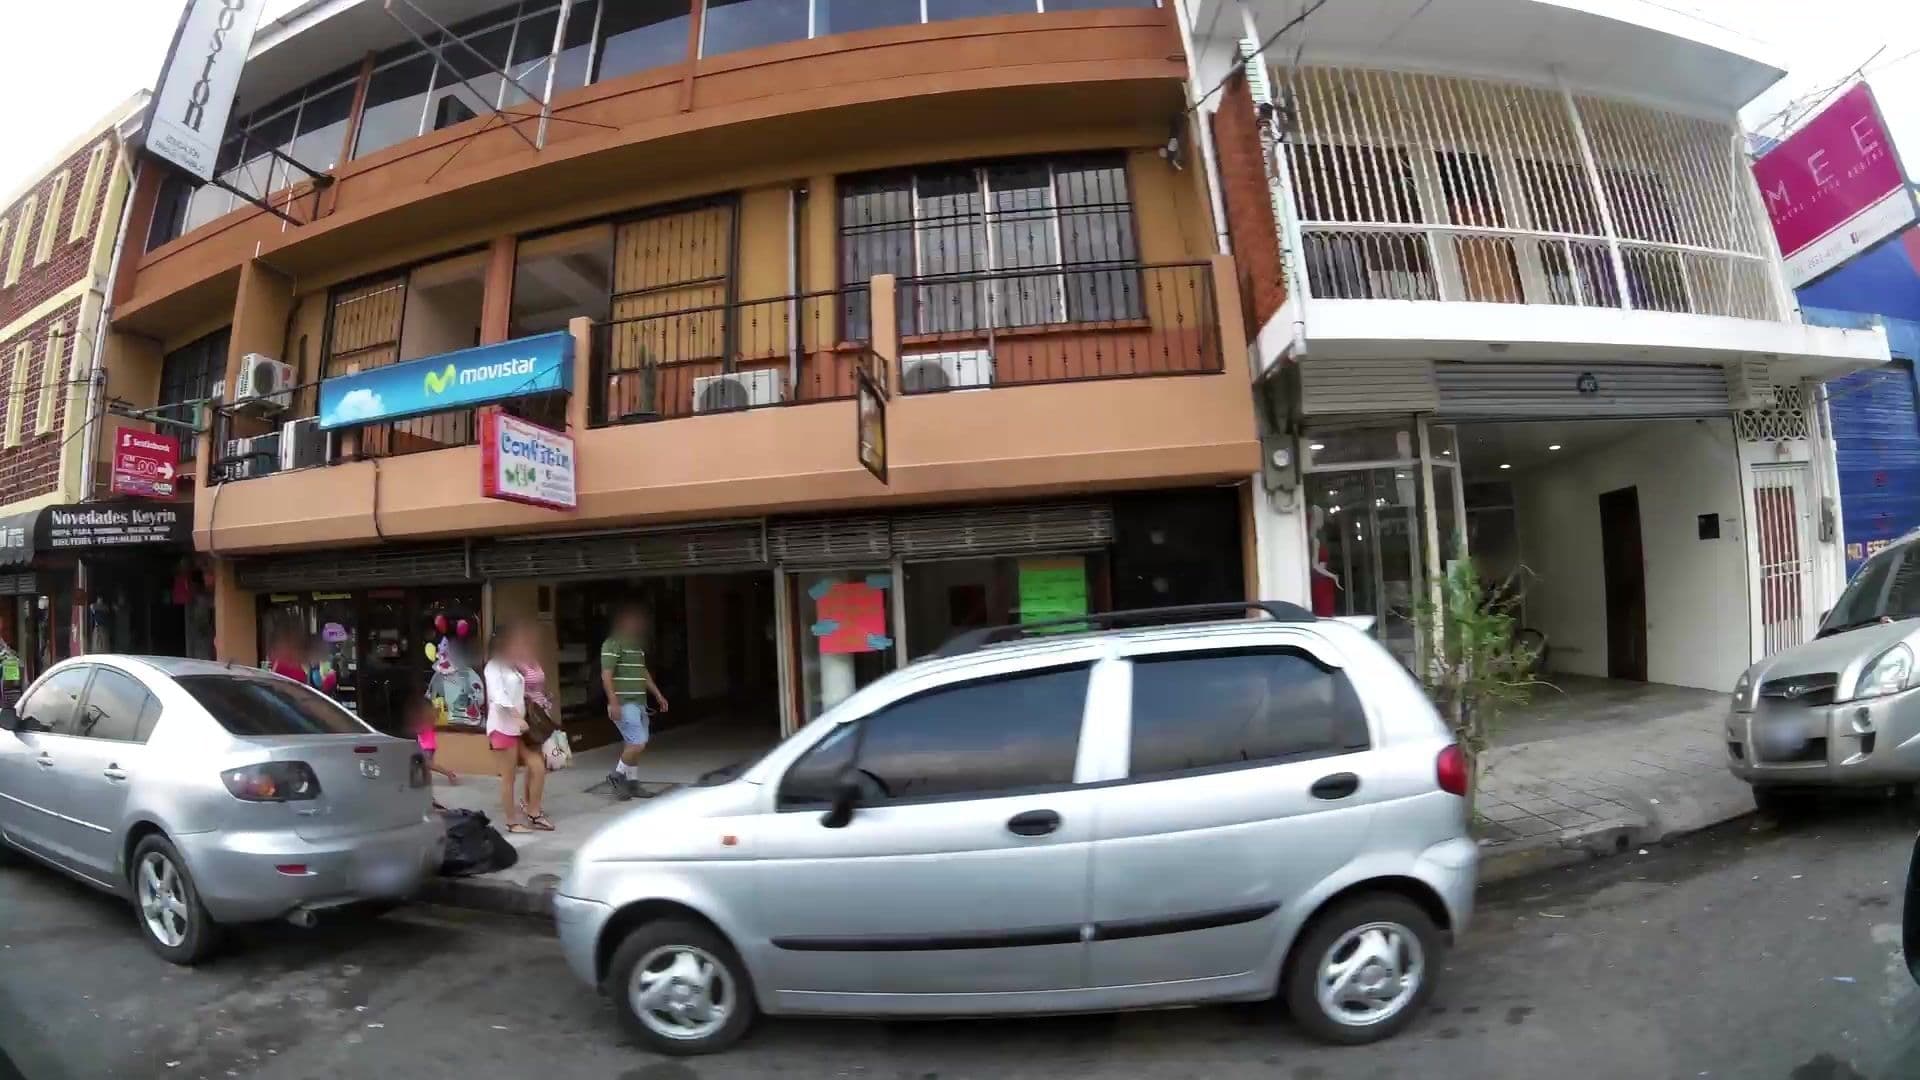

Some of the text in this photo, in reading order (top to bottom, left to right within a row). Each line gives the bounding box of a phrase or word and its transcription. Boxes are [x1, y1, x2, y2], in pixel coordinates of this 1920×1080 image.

[460, 357, 537, 385] movistar
[52, 508, 176, 526] Novedades Keyrin
